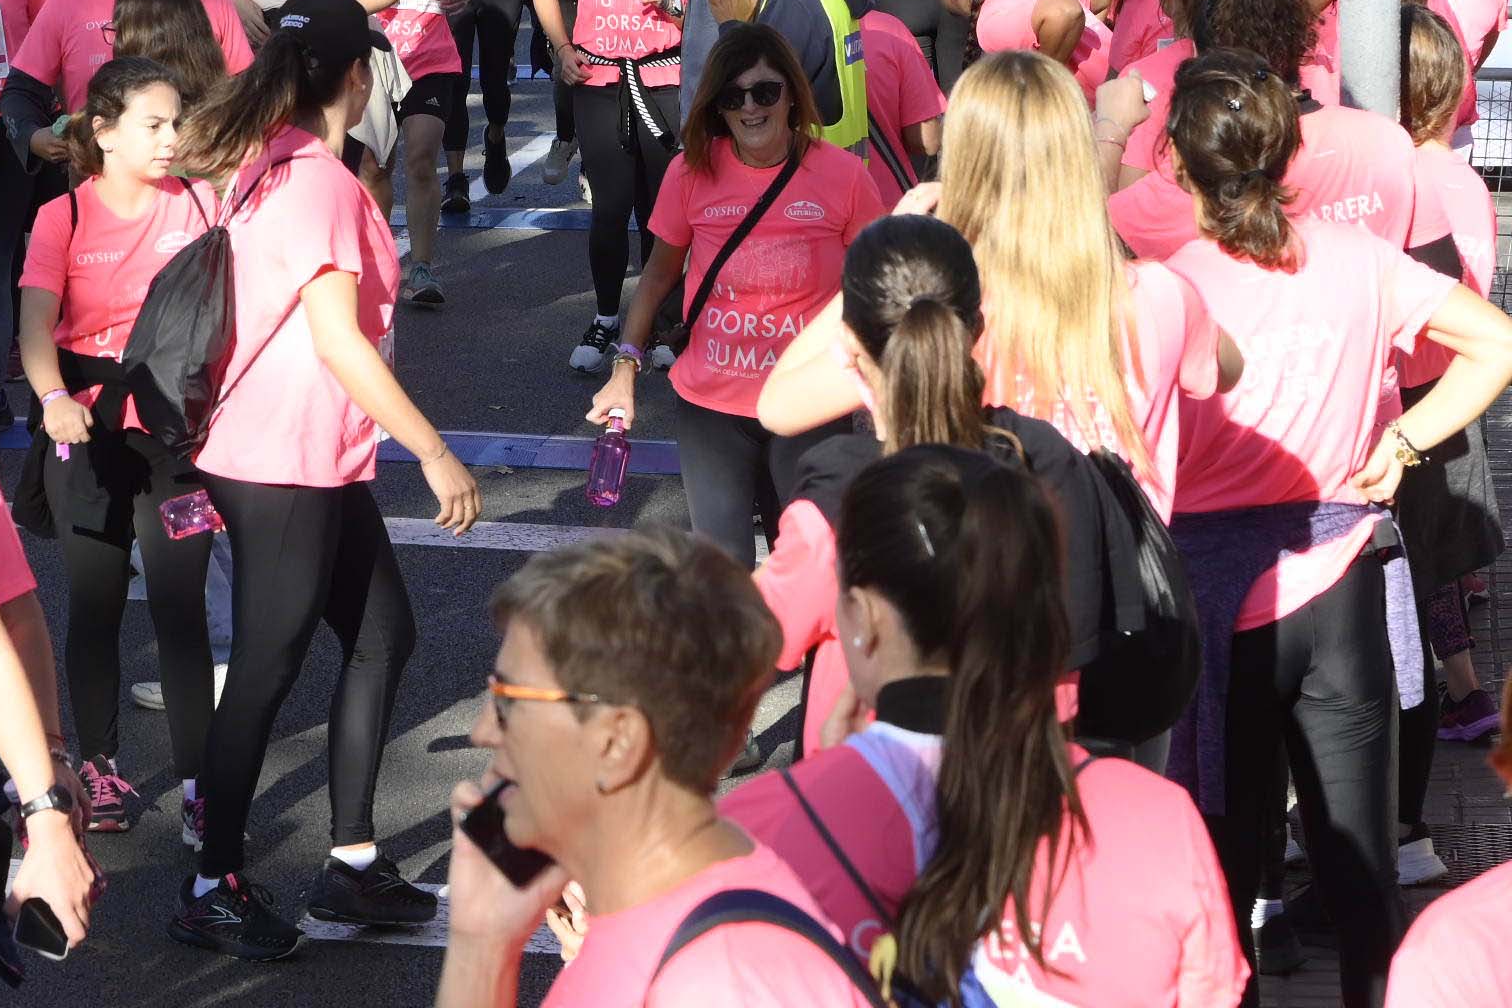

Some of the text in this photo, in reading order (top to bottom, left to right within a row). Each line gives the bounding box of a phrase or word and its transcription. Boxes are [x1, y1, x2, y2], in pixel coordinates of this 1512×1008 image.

[594, 14, 665, 32] DORSAL
[595, 36, 648, 53] SUMA
[704, 205, 747, 218] OYSHO
[76, 250, 126, 265] OYSHO
[706, 339, 778, 371] SUMA
